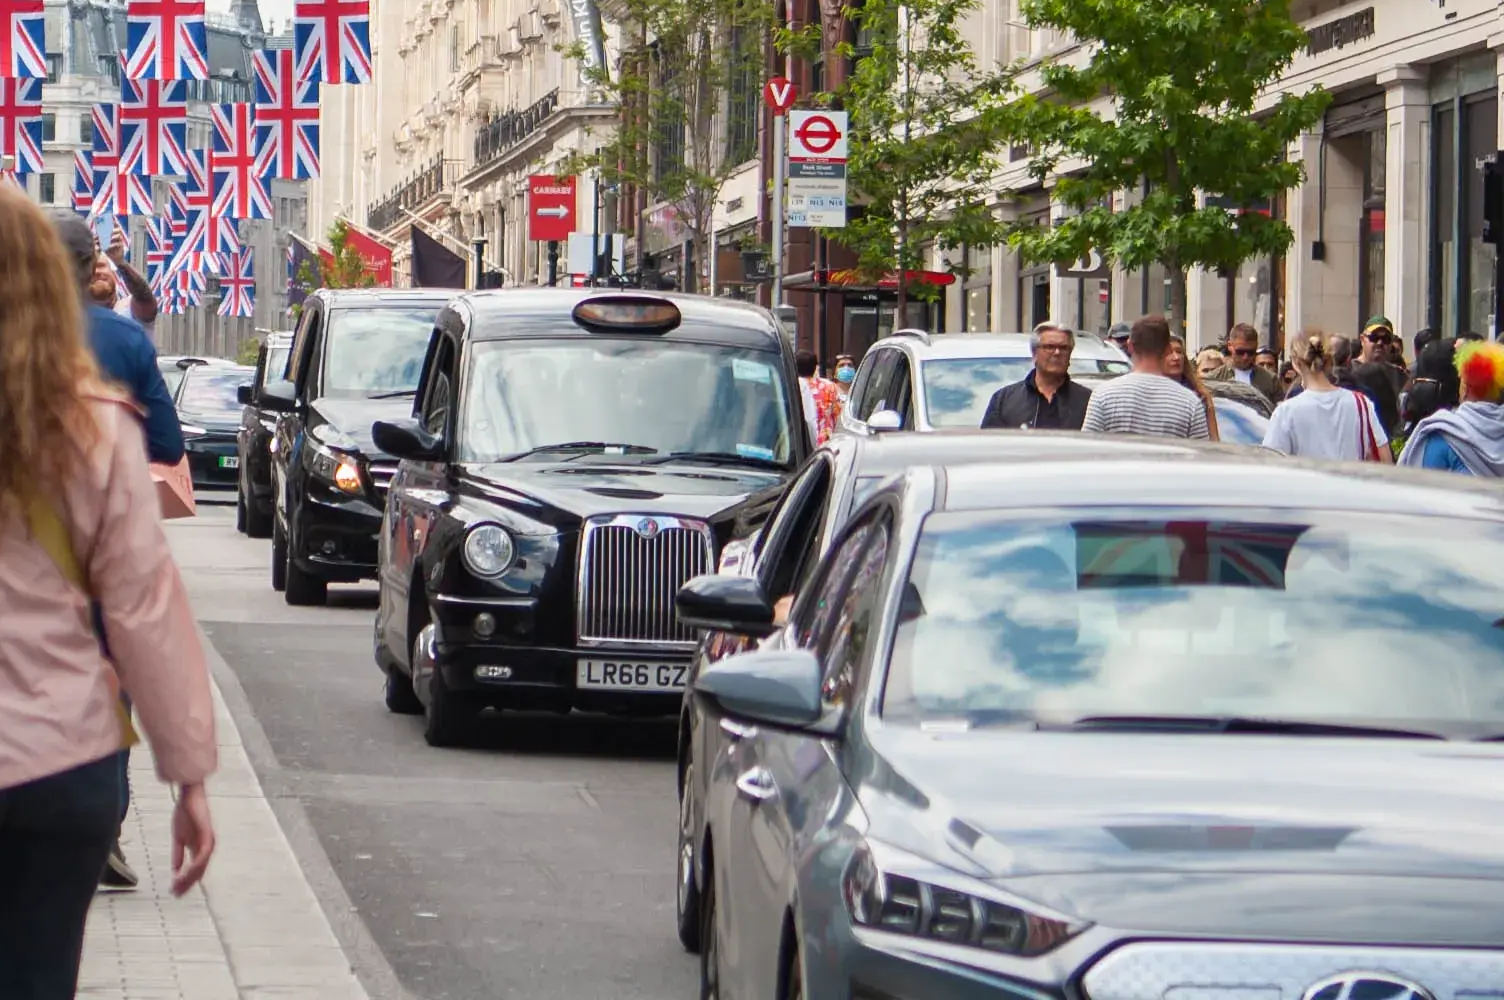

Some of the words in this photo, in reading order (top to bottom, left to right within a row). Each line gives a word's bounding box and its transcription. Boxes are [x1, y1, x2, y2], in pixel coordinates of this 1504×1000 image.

[770, 83, 791, 106] V
[586, 661, 649, 686] LR66
[656, 665, 692, 687] GZ
